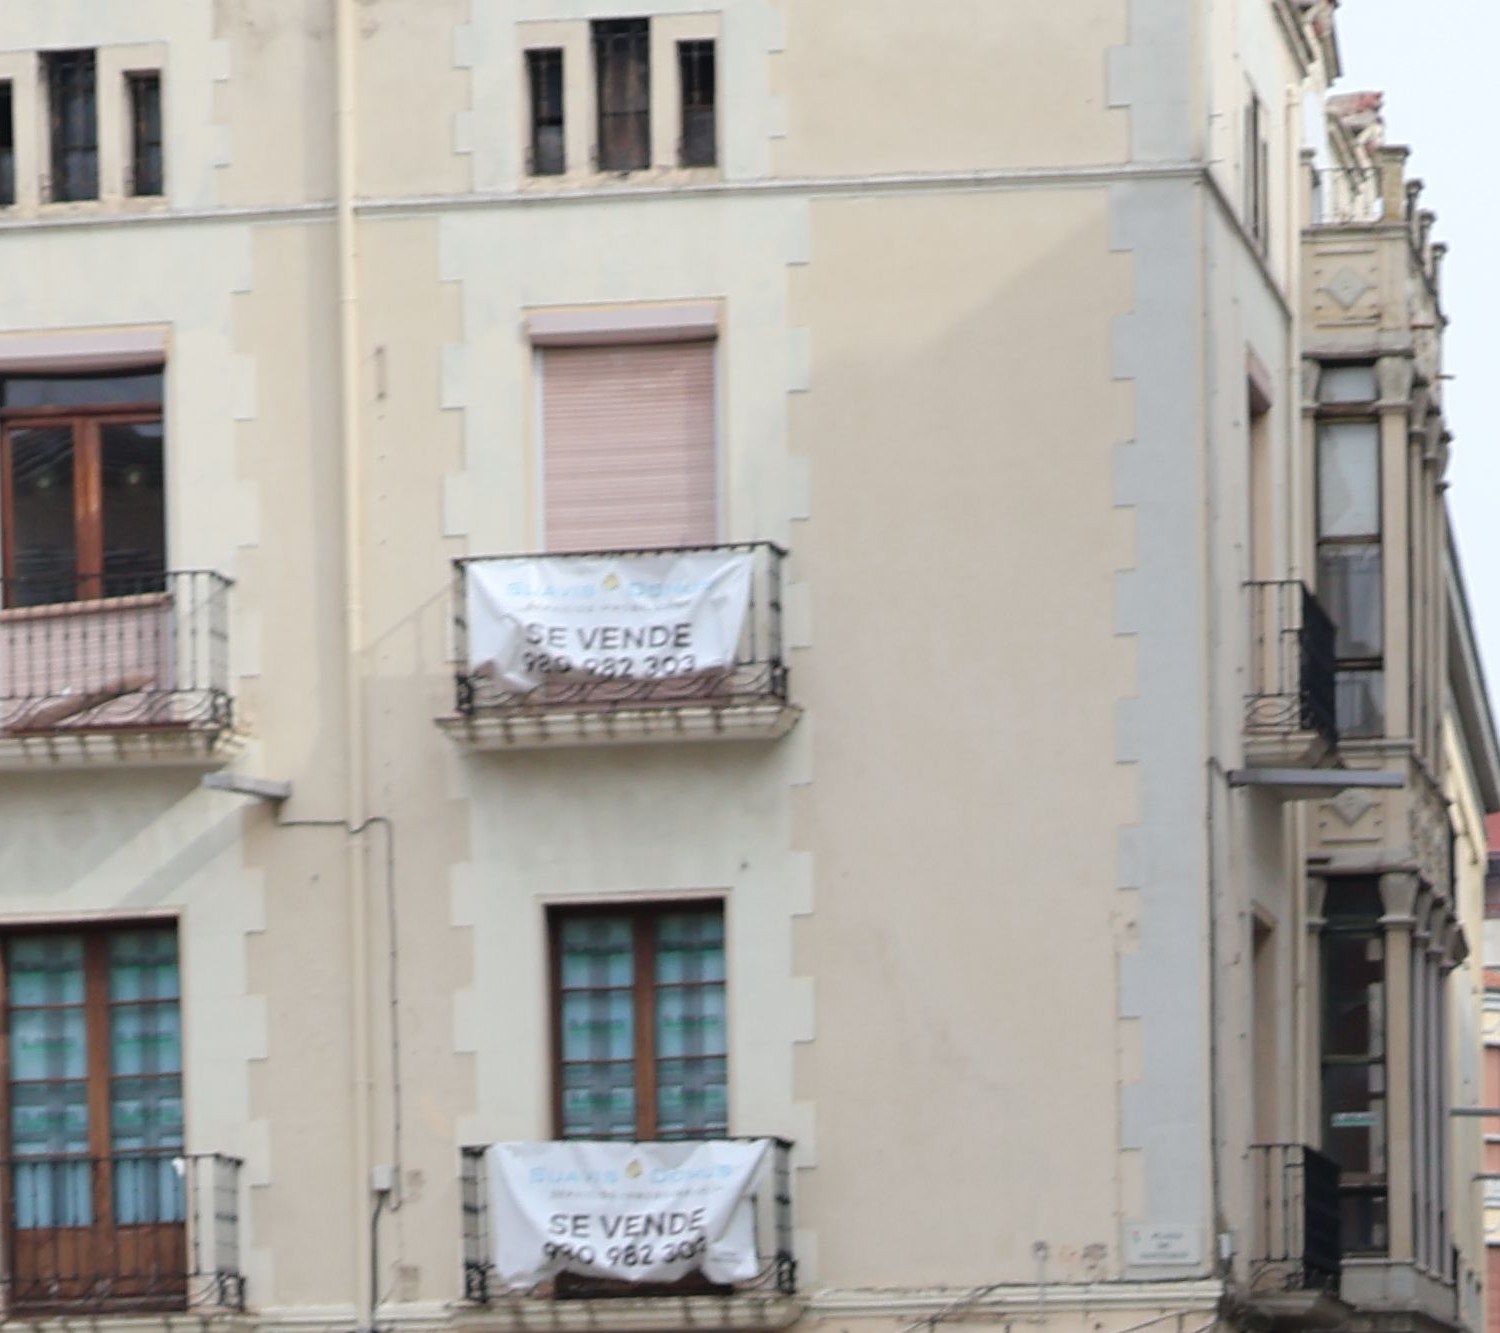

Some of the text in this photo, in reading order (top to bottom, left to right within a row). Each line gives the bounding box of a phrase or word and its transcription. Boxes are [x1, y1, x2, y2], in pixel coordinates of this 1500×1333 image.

[525, 622, 693, 650] SE VENDE
[548, 1207, 707, 1239] SE VENDE
[607, 1243, 653, 1267] 982
